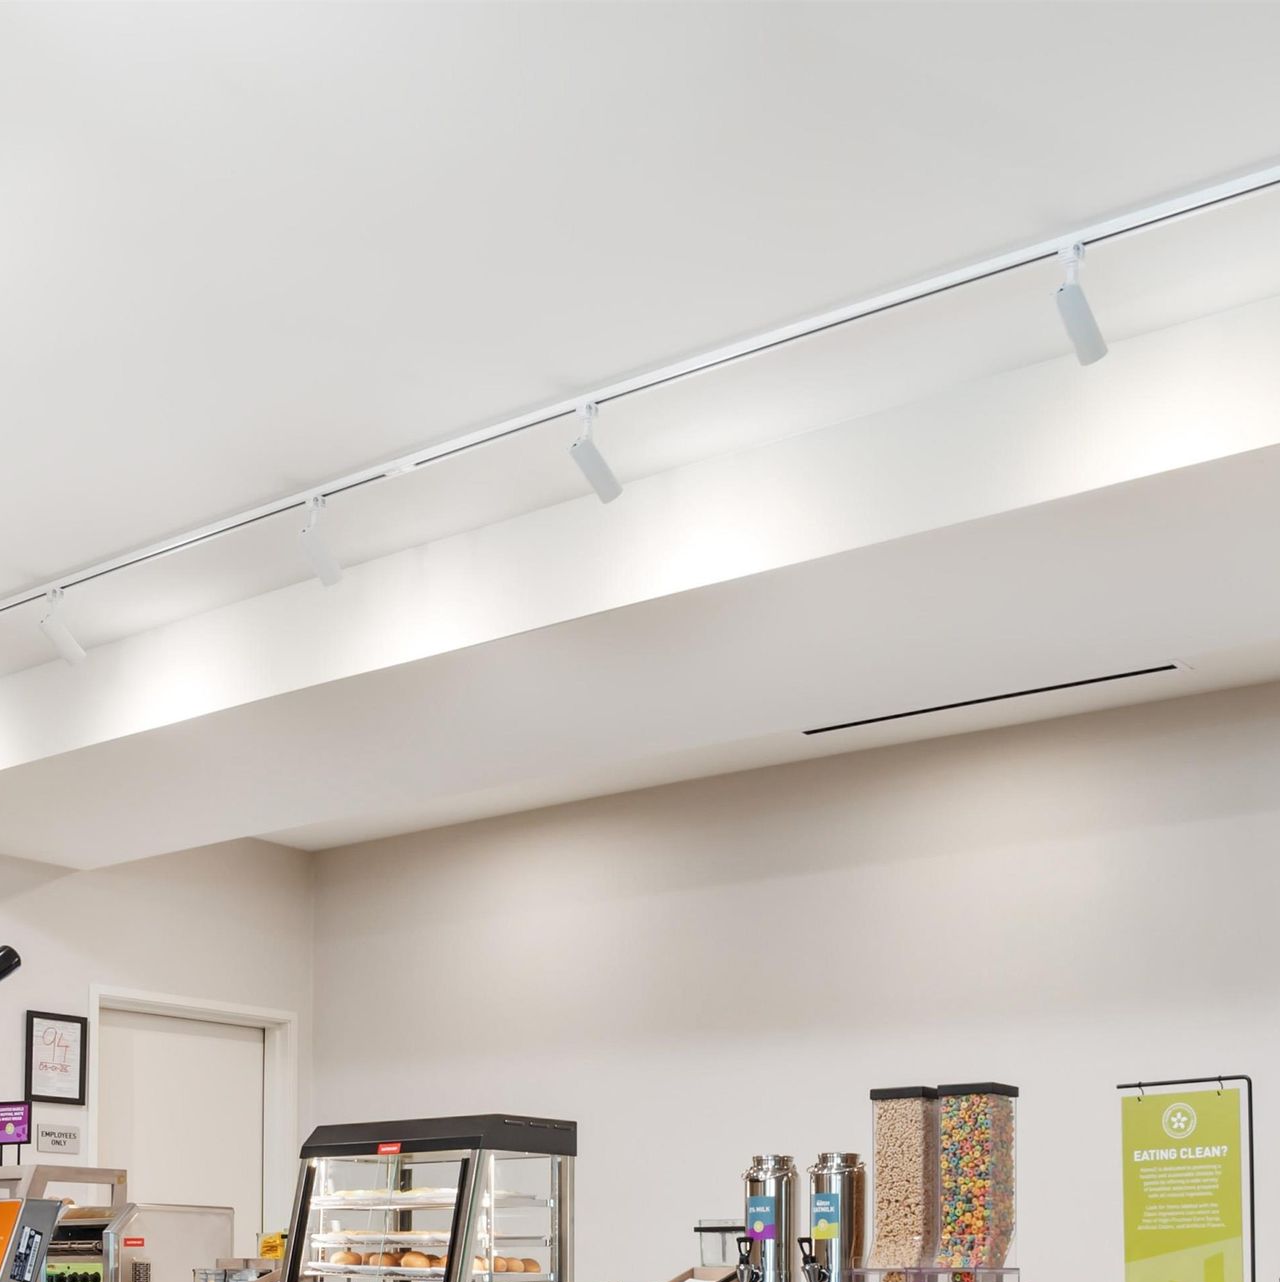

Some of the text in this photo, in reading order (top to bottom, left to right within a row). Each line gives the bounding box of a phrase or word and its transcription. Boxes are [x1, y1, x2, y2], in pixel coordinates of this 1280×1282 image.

[41, 1130, 77, 1140] EMPLOYEES
[51, 1139, 67, 1147] ONLY
[1133, 1145, 1228, 1162] EATING CLEAN?
